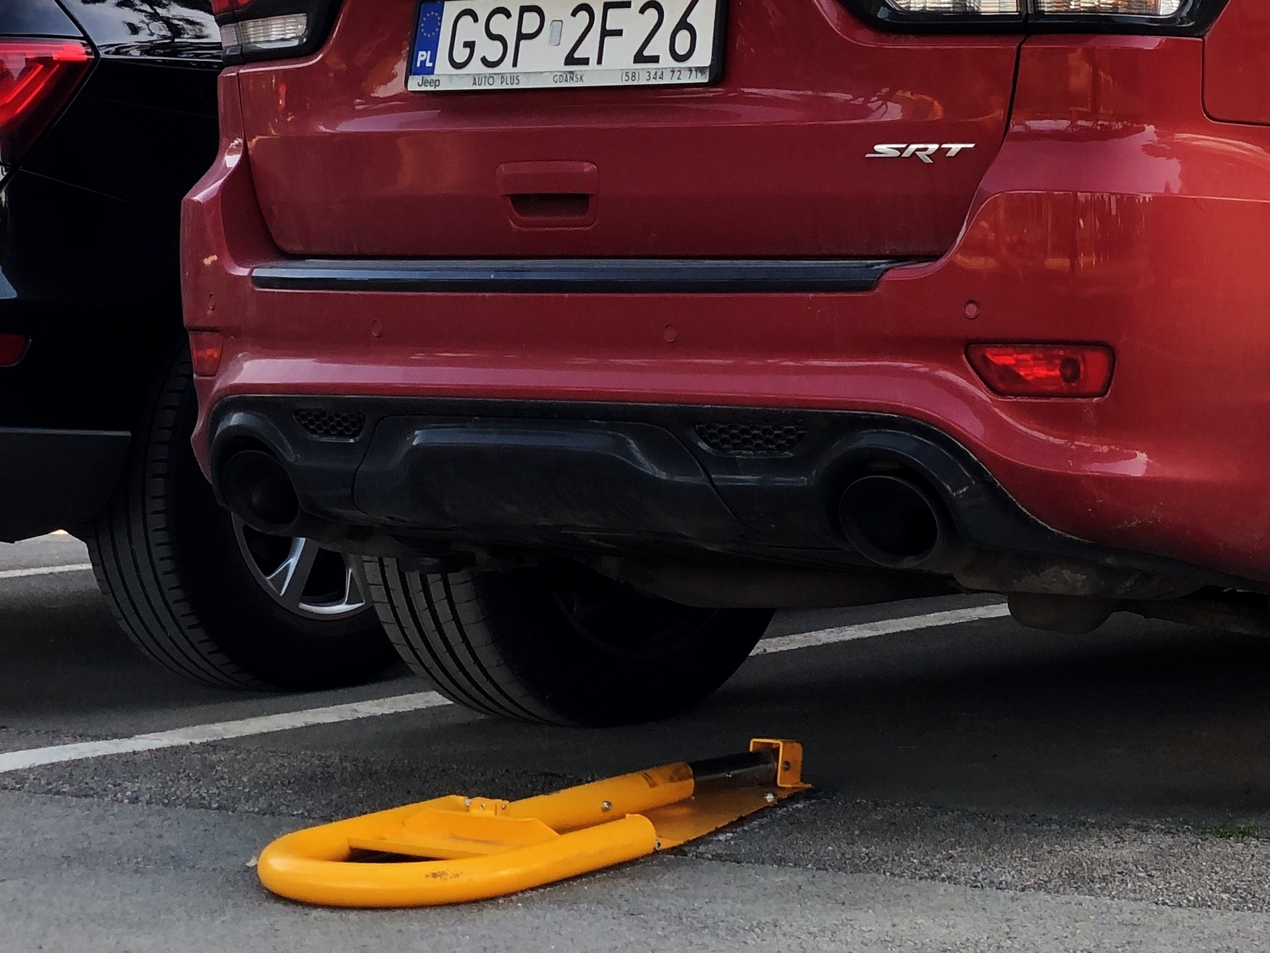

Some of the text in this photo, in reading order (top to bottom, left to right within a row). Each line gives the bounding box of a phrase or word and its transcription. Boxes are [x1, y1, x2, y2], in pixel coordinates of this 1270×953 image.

[447, 4, 546, 69] GSP
[416, 50, 433, 68] PL
[417, 76, 441, 89] Jeep
[472, 75, 495, 87] AUTO
[500, 74, 520, 86] PLUS
[620, 71, 641, 82] (58)
[646, 69, 664, 81] 344
[669, 69, 682, 81] 72
[864, 142, 977, 164] SRT
